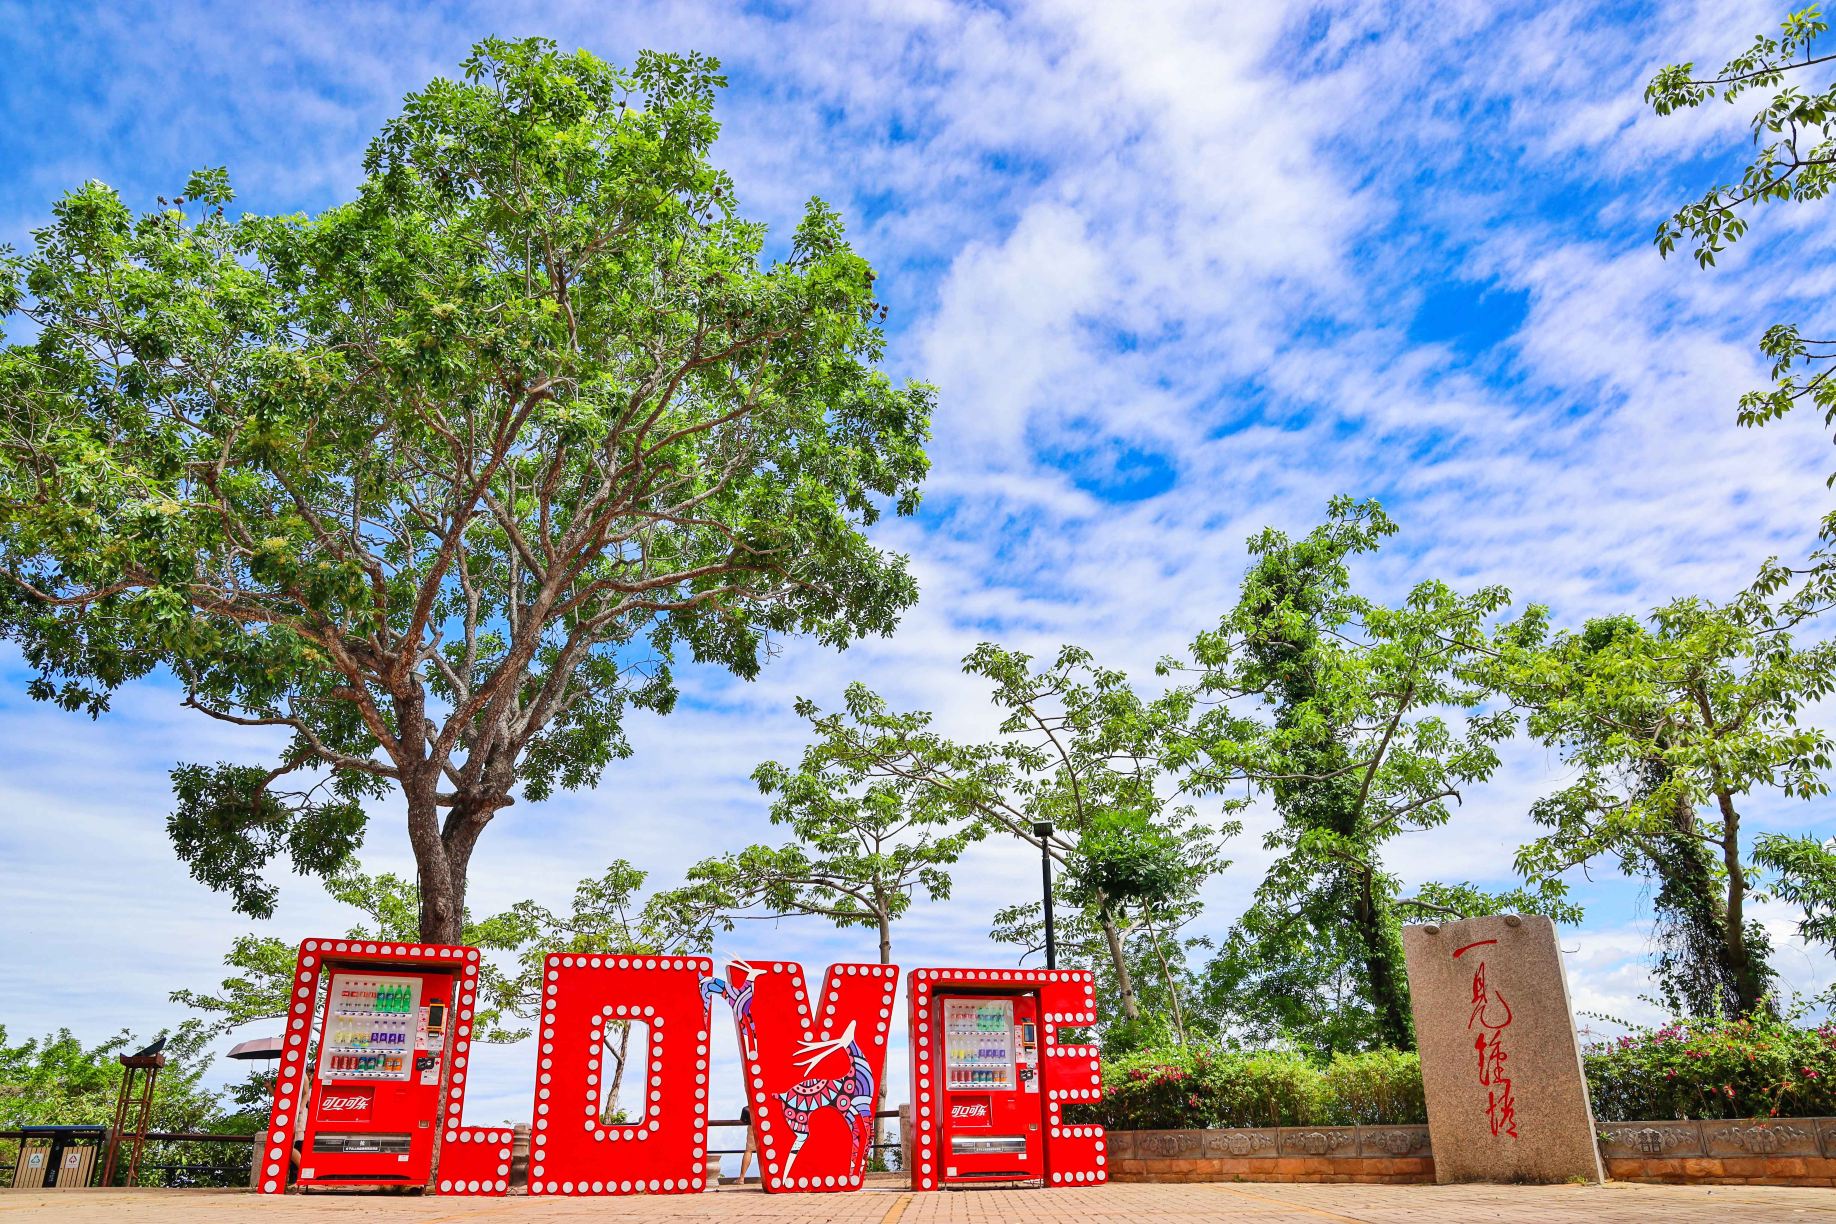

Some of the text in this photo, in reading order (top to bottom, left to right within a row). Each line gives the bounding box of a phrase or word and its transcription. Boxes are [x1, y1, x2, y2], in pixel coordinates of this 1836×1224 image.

[258, 938, 1108, 1196] LOVE
[322, 1096, 372, 1110] 可口可乐
[952, 1104, 988, 1117] 可口可乐
